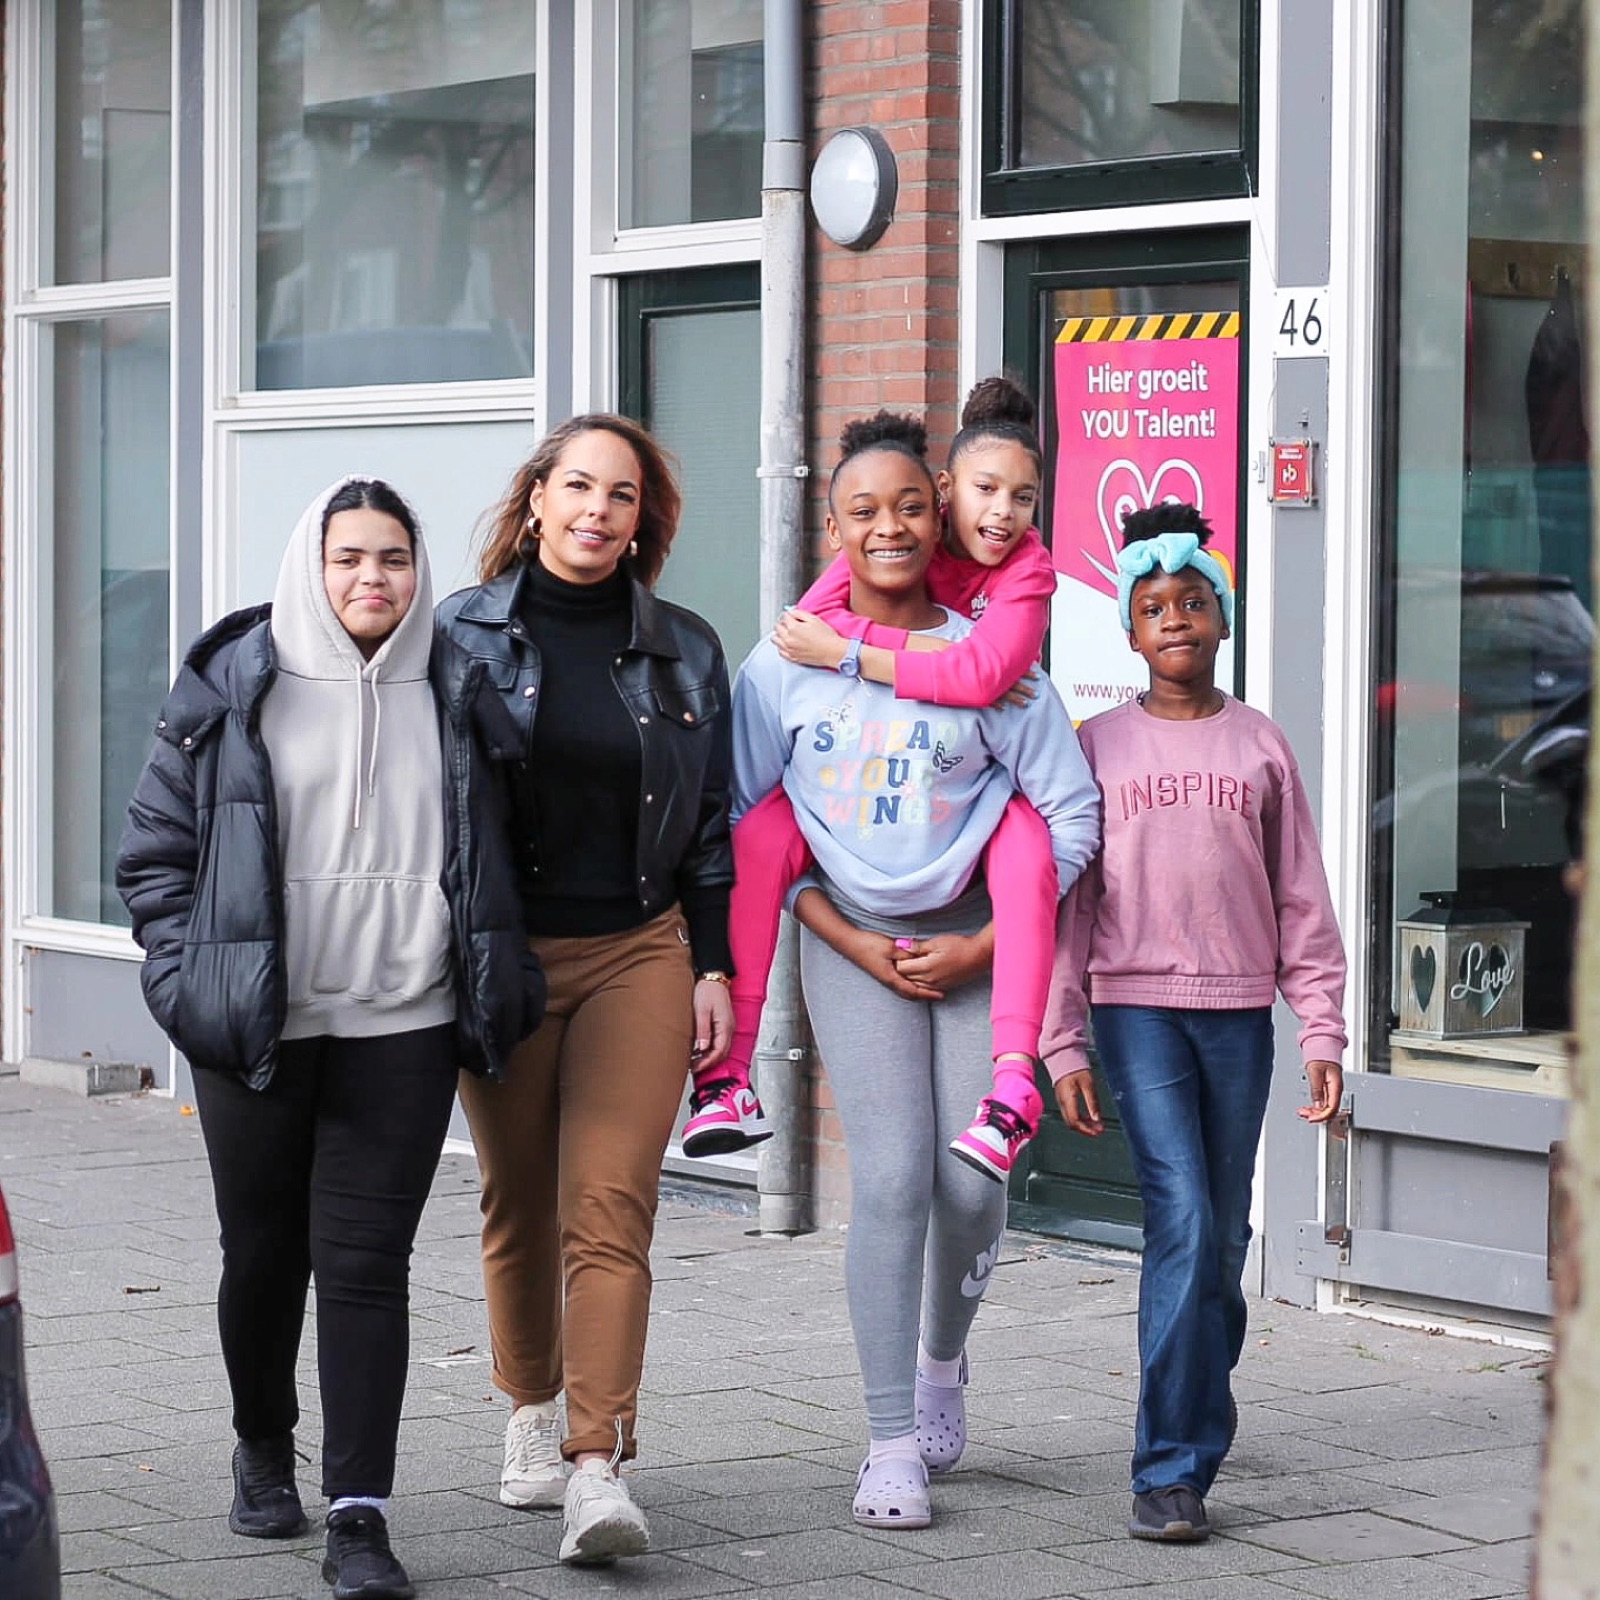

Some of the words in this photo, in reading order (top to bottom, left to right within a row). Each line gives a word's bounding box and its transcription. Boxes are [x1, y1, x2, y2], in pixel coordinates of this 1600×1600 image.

[1279, 298, 1322, 346] 46
[1088, 363, 1133, 393] Hier
[1138, 361, 1208, 399] groeit
[1082, 409, 1129, 439] YOU
[1134, 408, 1216, 438] Talent!
[1120, 771, 1255, 820] INSPIRE
[1450, 942, 1515, 1000] Love
